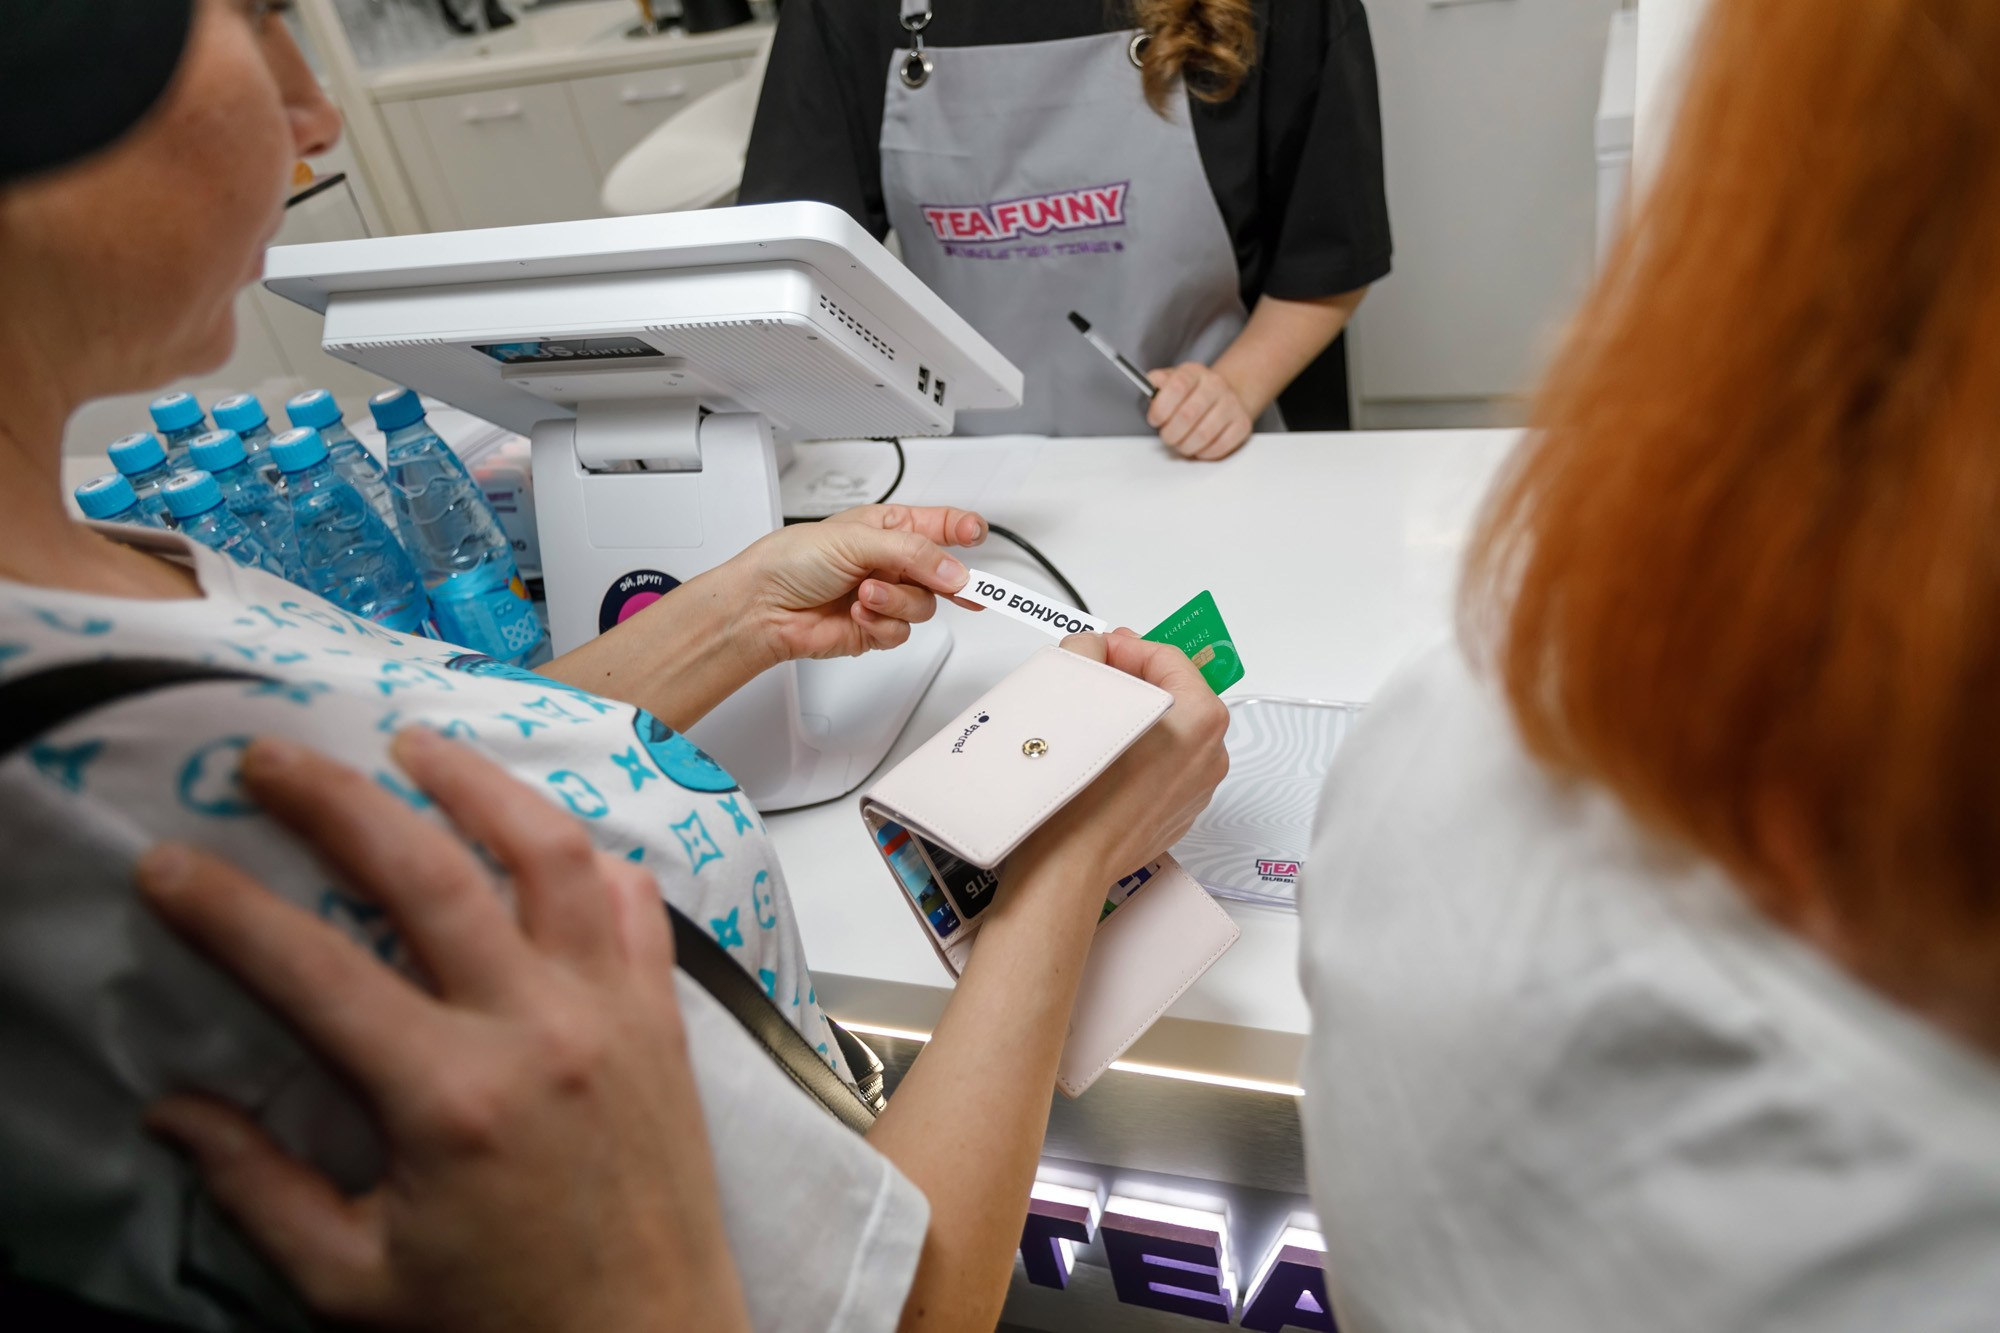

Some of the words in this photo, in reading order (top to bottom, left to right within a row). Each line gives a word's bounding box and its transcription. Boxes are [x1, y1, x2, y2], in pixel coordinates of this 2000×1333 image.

[925, 207, 994, 239] TEA
[993, 185, 1122, 236] FUNNY
[974, 580, 1006, 602] 100
[951, 724, 980, 753] panda
[1260, 861, 1299, 875] TEA
[1261, 876, 1297, 884] BUBBL
[1020, 1198, 1336, 1333] TEA
